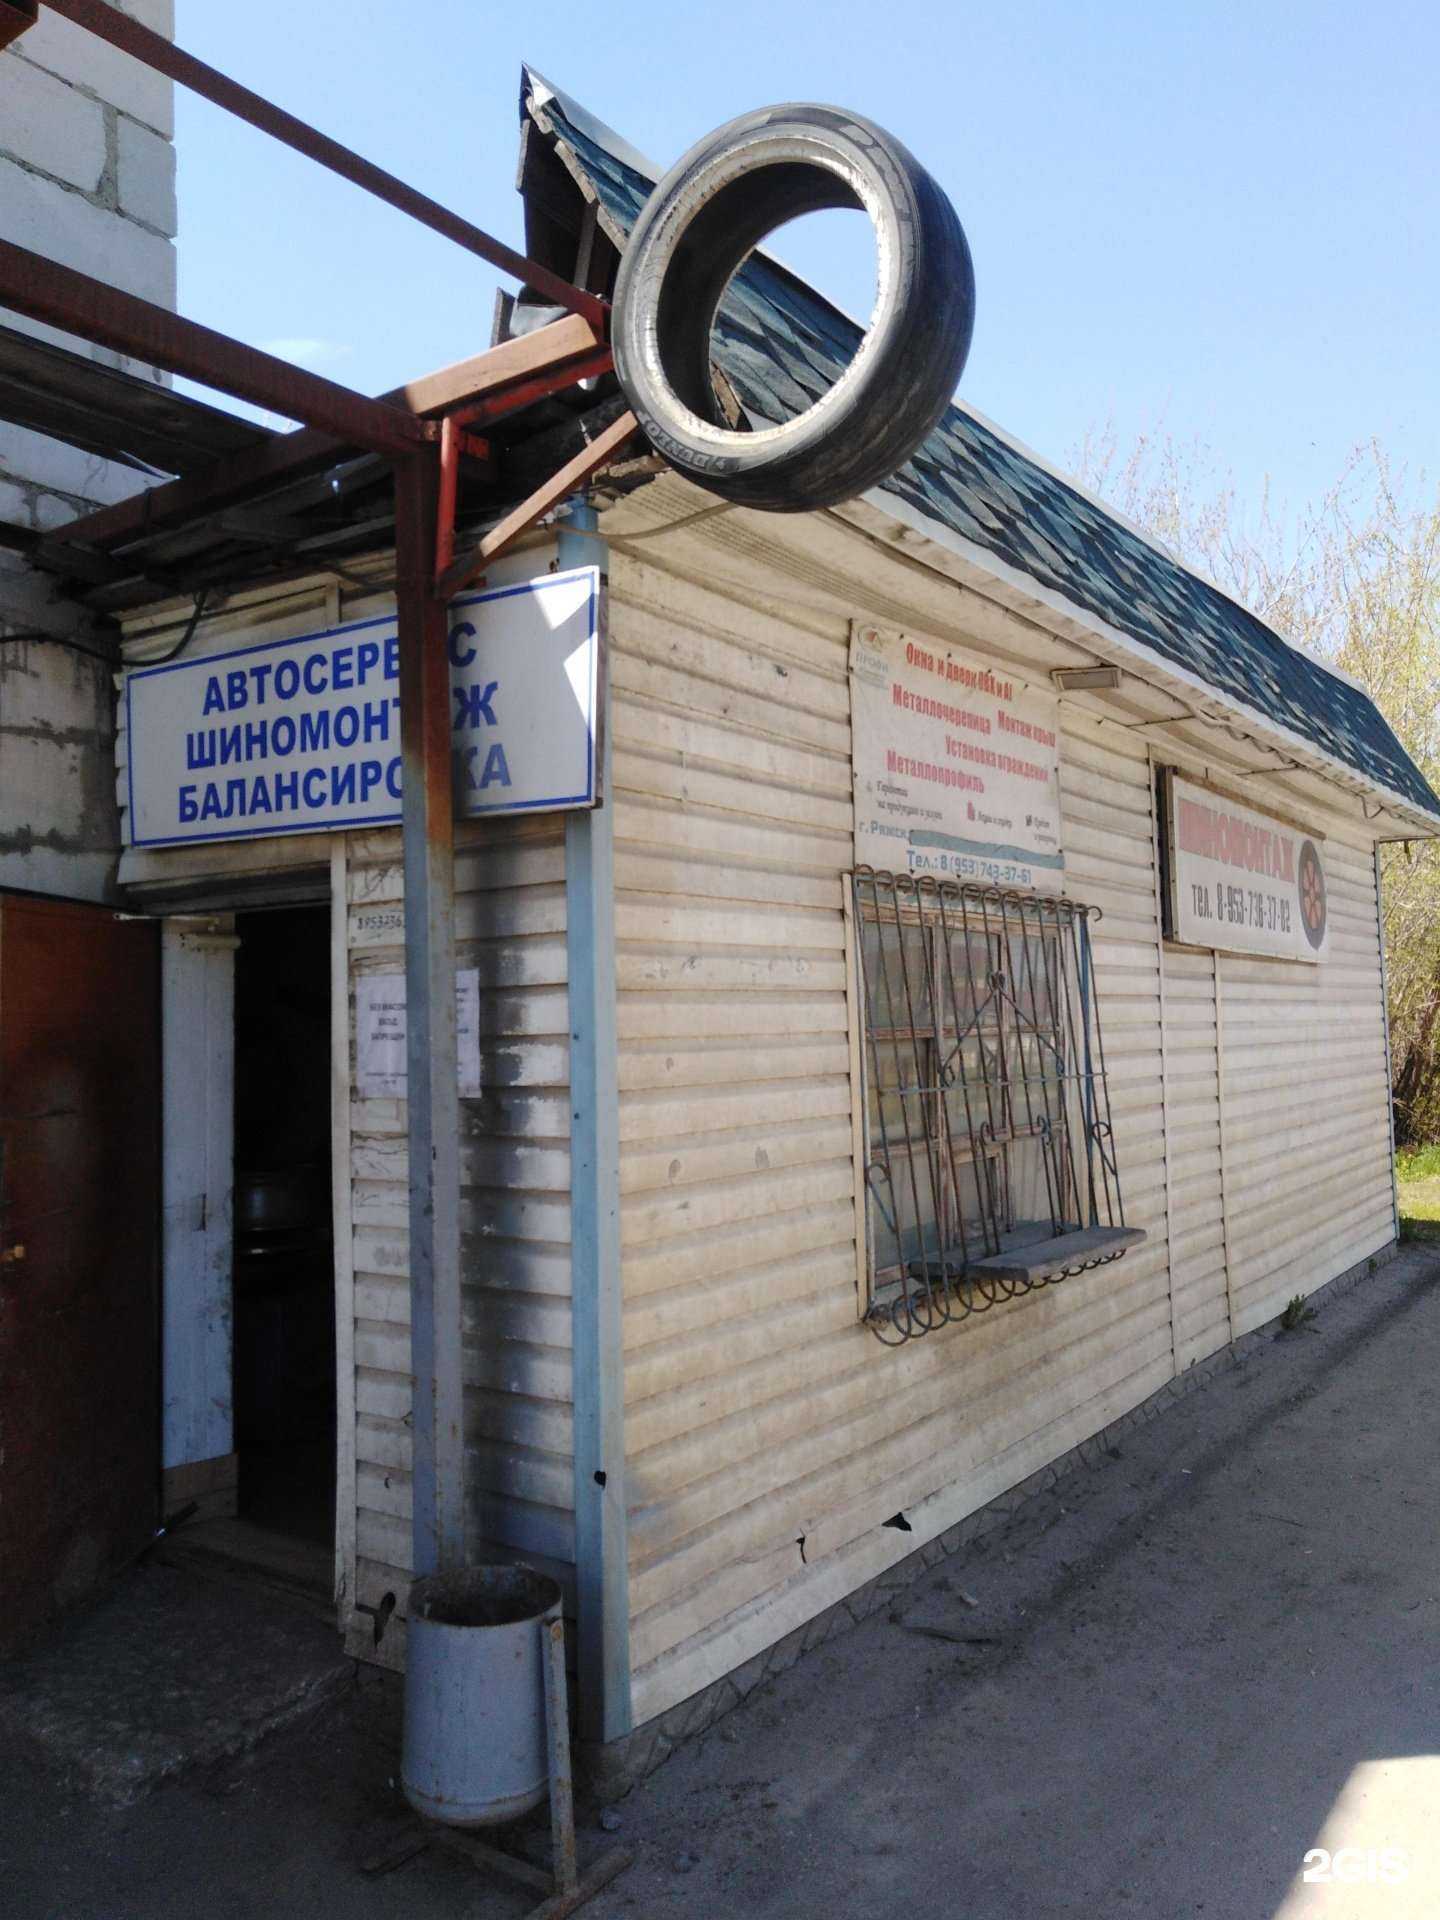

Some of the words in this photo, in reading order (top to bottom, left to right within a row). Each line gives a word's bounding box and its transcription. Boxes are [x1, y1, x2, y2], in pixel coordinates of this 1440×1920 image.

[202, 621, 477, 716] АВТОСЕРВС
[186, 681, 498, 770] ШИНОМОНЖ
[892, 683, 991, 736] Металлочерепица
[998, 710, 1033, 740] Монтаж
[887, 749, 985, 794] Металлопрофиль
[945, 735, 996, 768] Установка
[178, 743, 512, 823] БАЛАНСИРОКА
